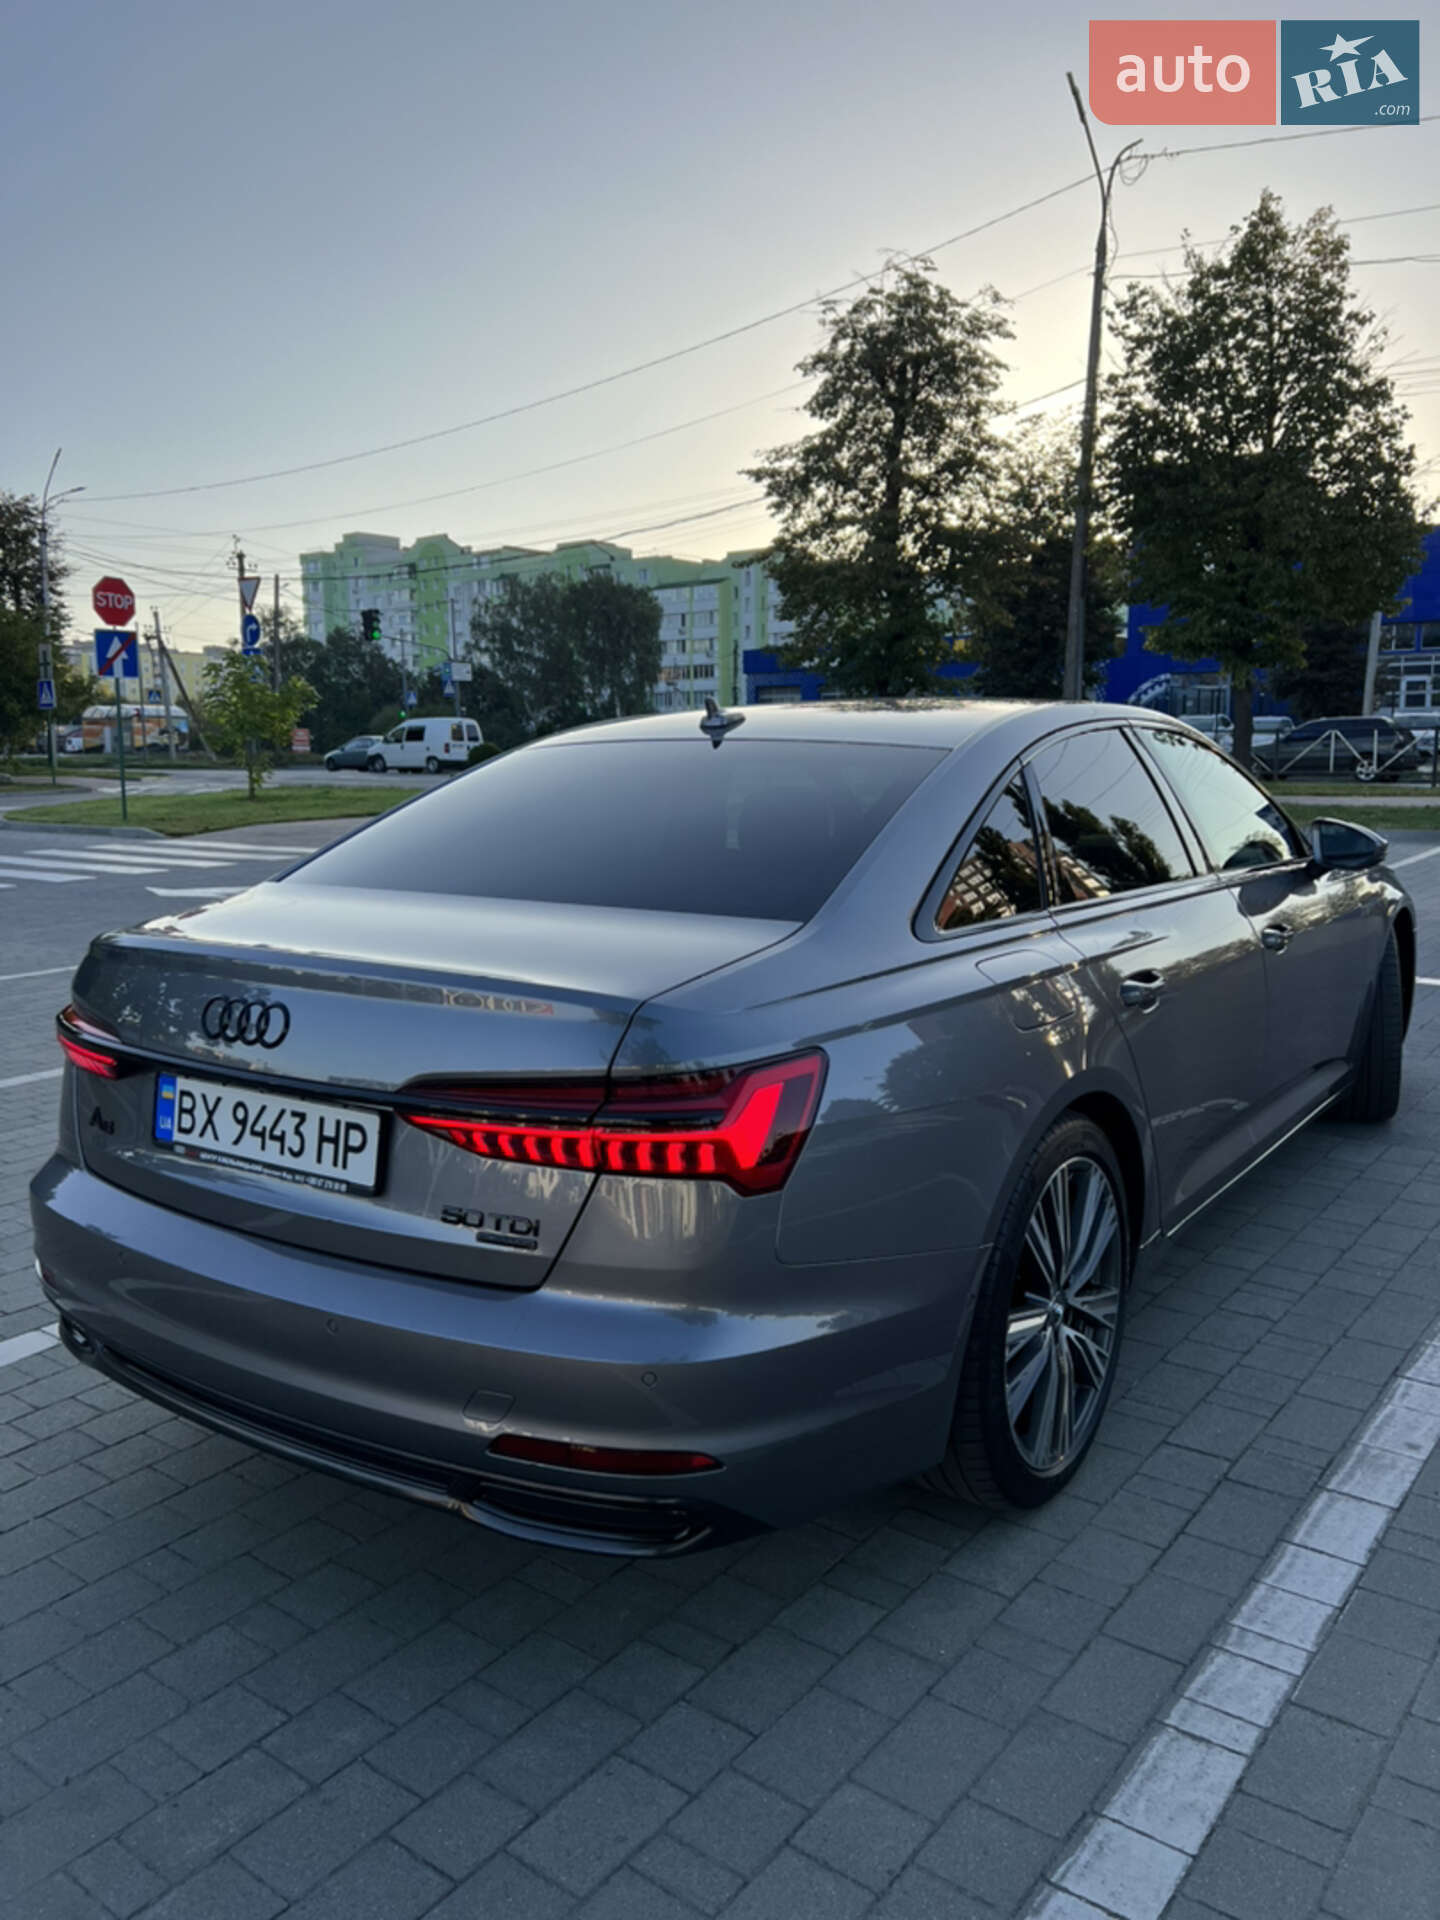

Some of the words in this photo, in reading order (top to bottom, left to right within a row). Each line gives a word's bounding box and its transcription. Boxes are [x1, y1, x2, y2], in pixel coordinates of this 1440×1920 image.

[95, 592, 134, 609] STOP
[159, 1116, 172, 1129] UA
[177, 1090, 223, 1141] BX
[231, 1100, 307, 1158] 9443
[316, 1116, 367, 1170] HP
[441, 1205, 484, 1228] 50
[487, 1212, 540, 1237] TDI
